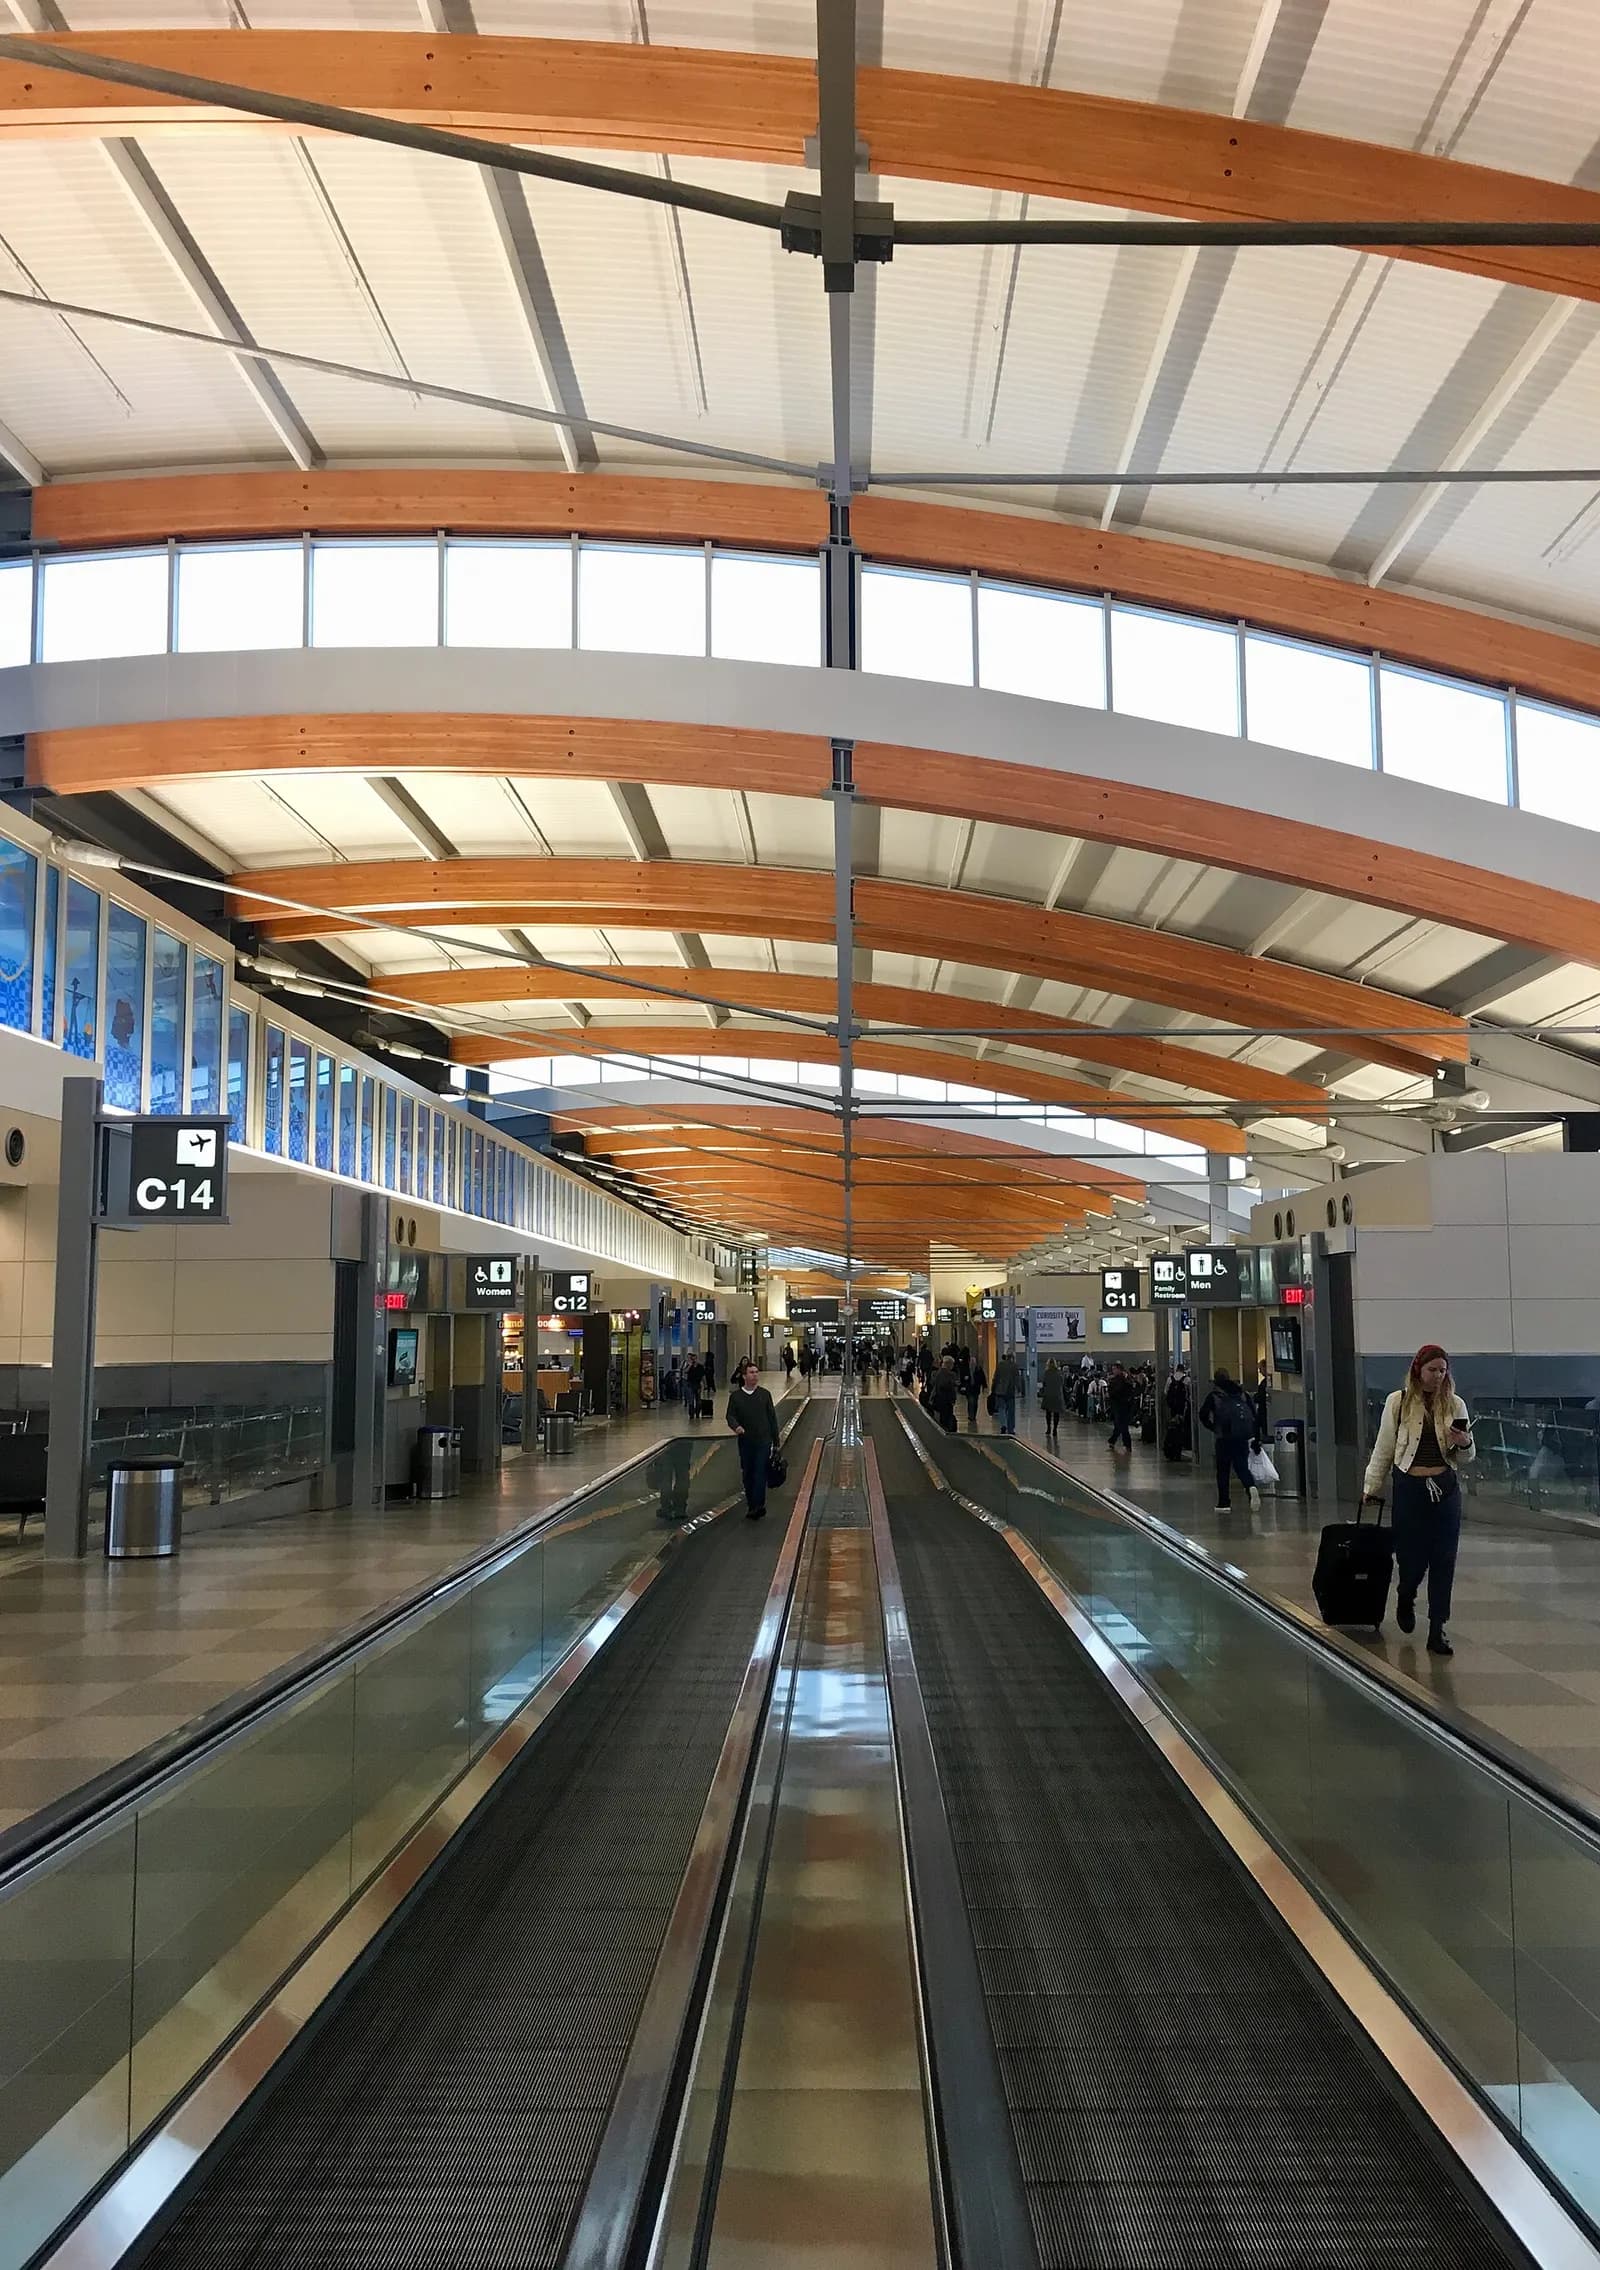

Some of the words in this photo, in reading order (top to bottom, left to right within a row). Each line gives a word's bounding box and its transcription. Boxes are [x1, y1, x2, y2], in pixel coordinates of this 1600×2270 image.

[136, 1177, 215, 1210] C14
[1154, 1285, 1175, 1293] Family
[1190, 1280, 1212, 1289] Men
[476, 1287, 512, 1296] Women
[1285, 1289, 1303, 1303] EXIT
[387, 1294, 405, 1309] EXIT
[554, 1296, 588, 1311] C12
[1105, 1292, 1137, 1307] C11
[696, 1311, 715, 1320] C10
[982, 1309, 996, 1319] C9
